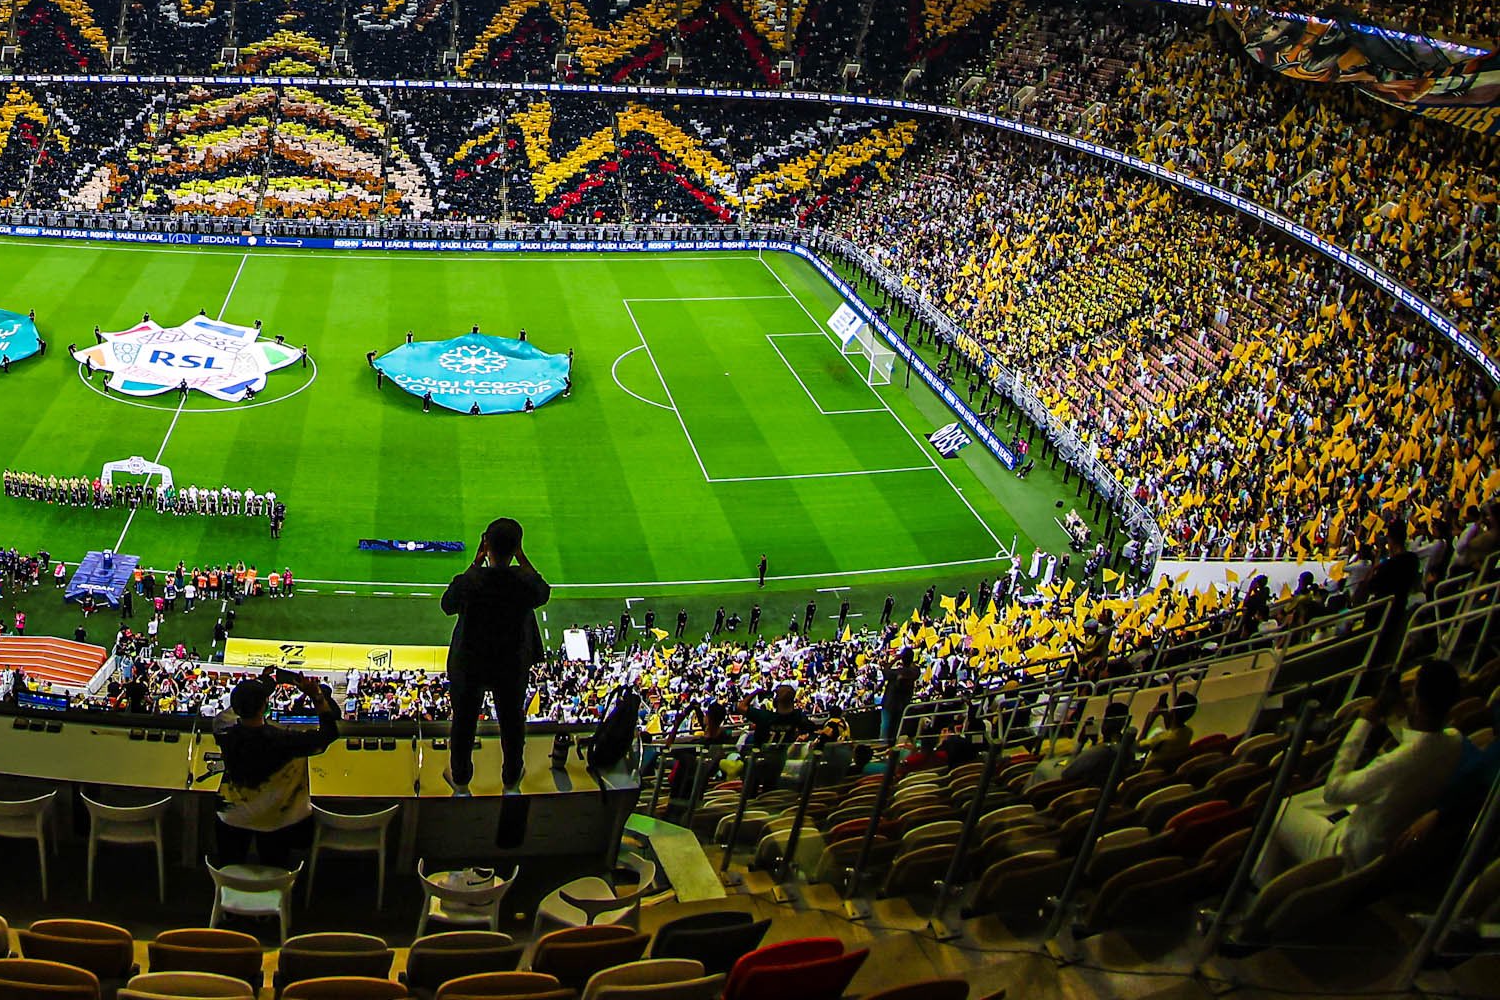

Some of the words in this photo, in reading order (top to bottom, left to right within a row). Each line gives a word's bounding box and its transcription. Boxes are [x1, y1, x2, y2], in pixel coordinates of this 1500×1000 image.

[198, 236, 240, 244] JEDDAH
[150, 350, 224, 369] RSL
[474, 384, 552, 396] GROUP
